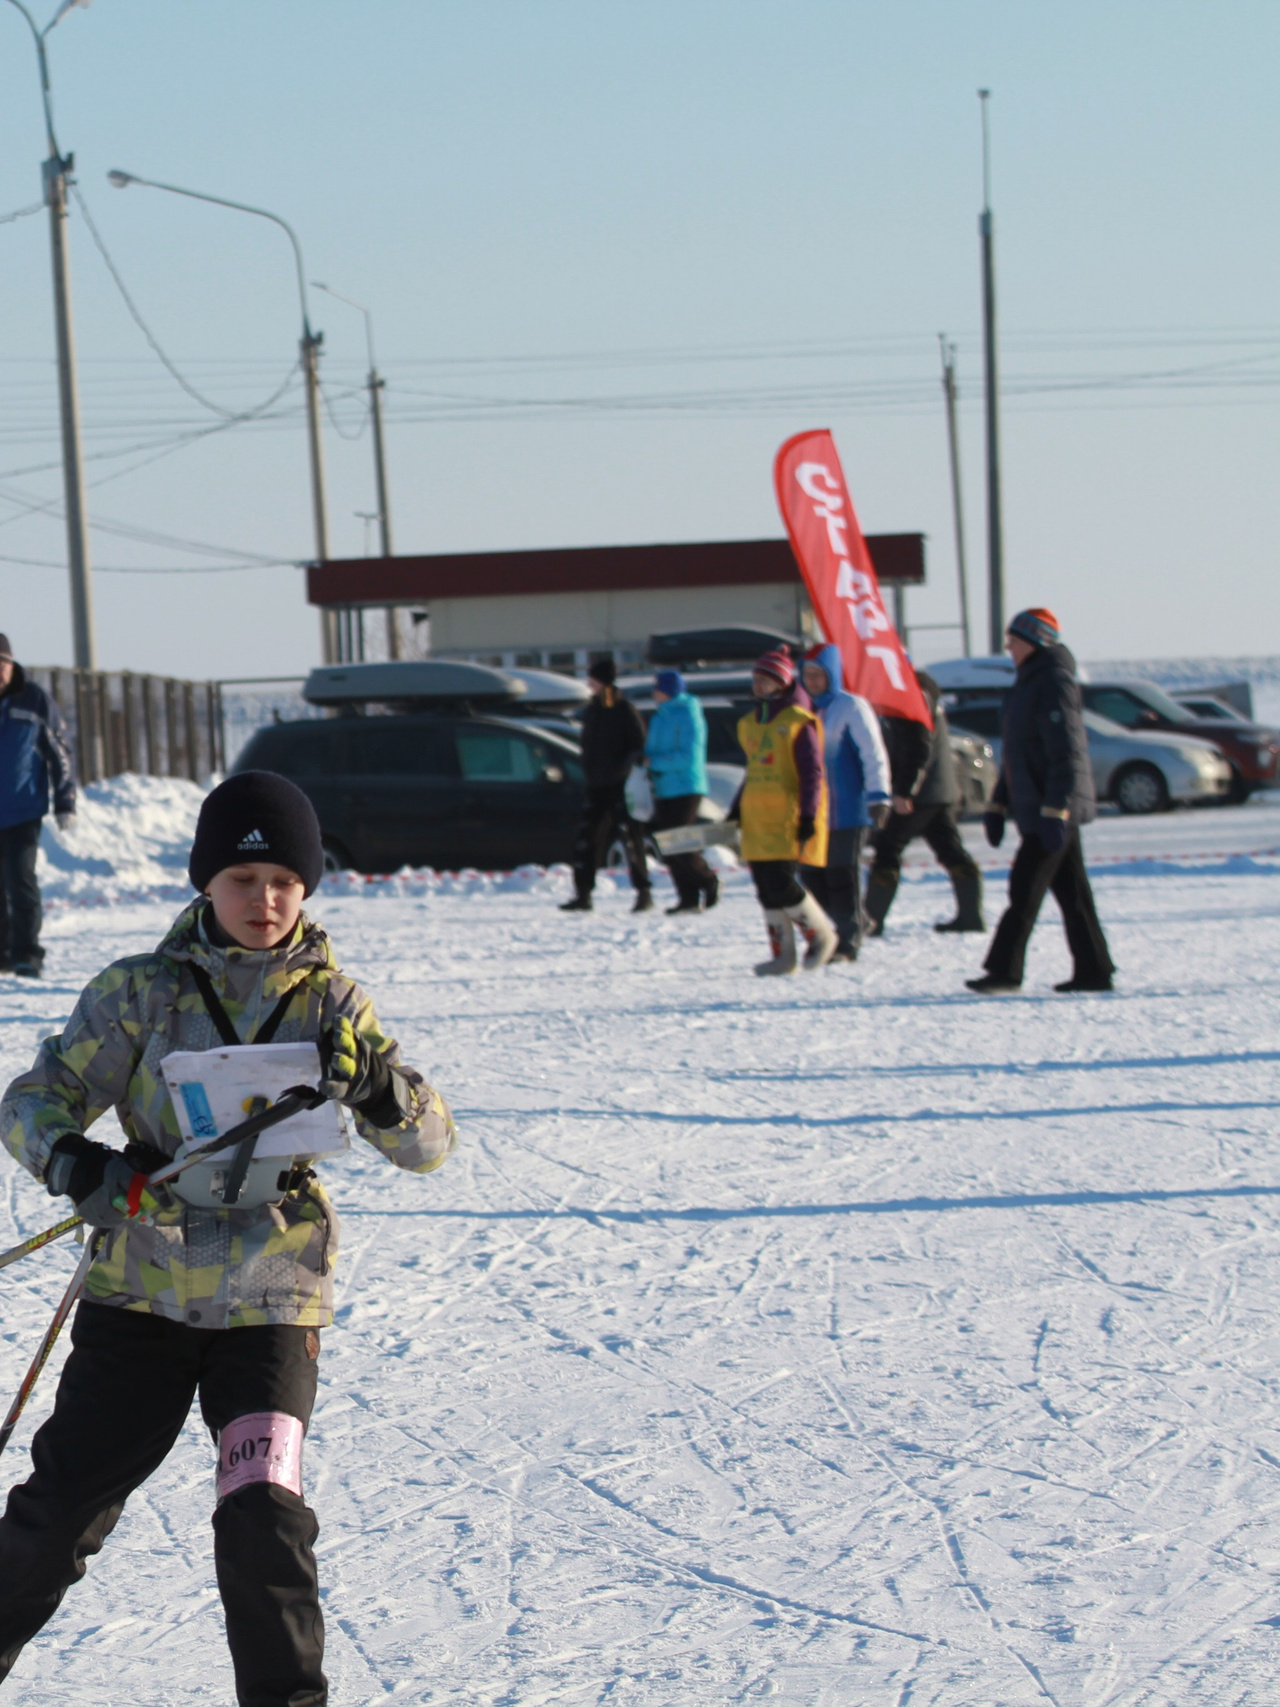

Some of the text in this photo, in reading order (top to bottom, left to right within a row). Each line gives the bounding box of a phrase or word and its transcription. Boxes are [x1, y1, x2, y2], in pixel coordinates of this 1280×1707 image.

[795, 461, 907, 691] СТАРТ
[237, 842, 269, 850] adidas
[229, 1437, 273, 1467] 607
